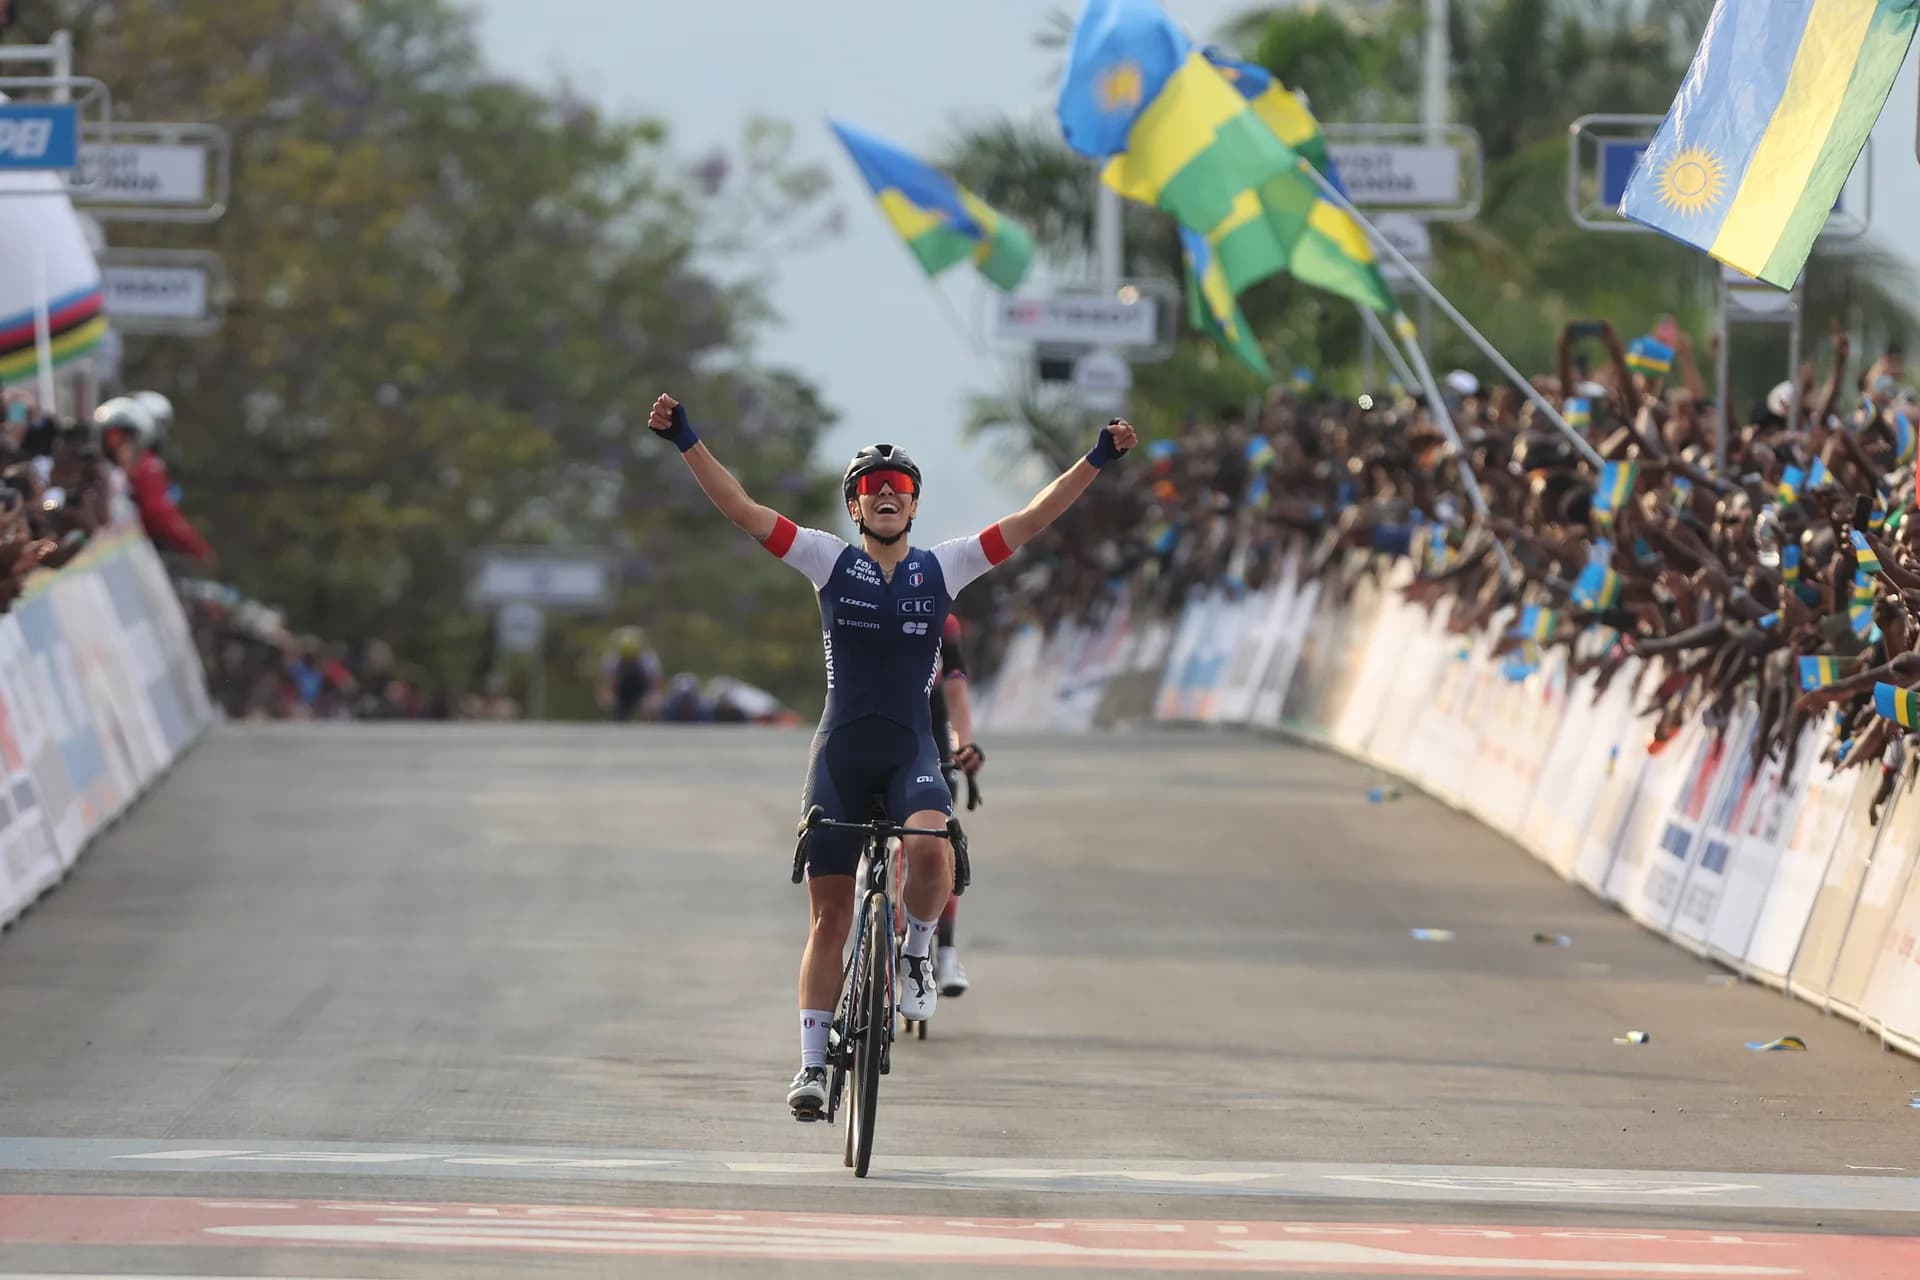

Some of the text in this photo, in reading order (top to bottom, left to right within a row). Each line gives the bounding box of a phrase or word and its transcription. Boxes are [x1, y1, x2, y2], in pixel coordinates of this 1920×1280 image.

[839, 596, 880, 609] LOOK
[901, 600, 932, 612] CIC
[822, 629, 835, 689] FRANCE
